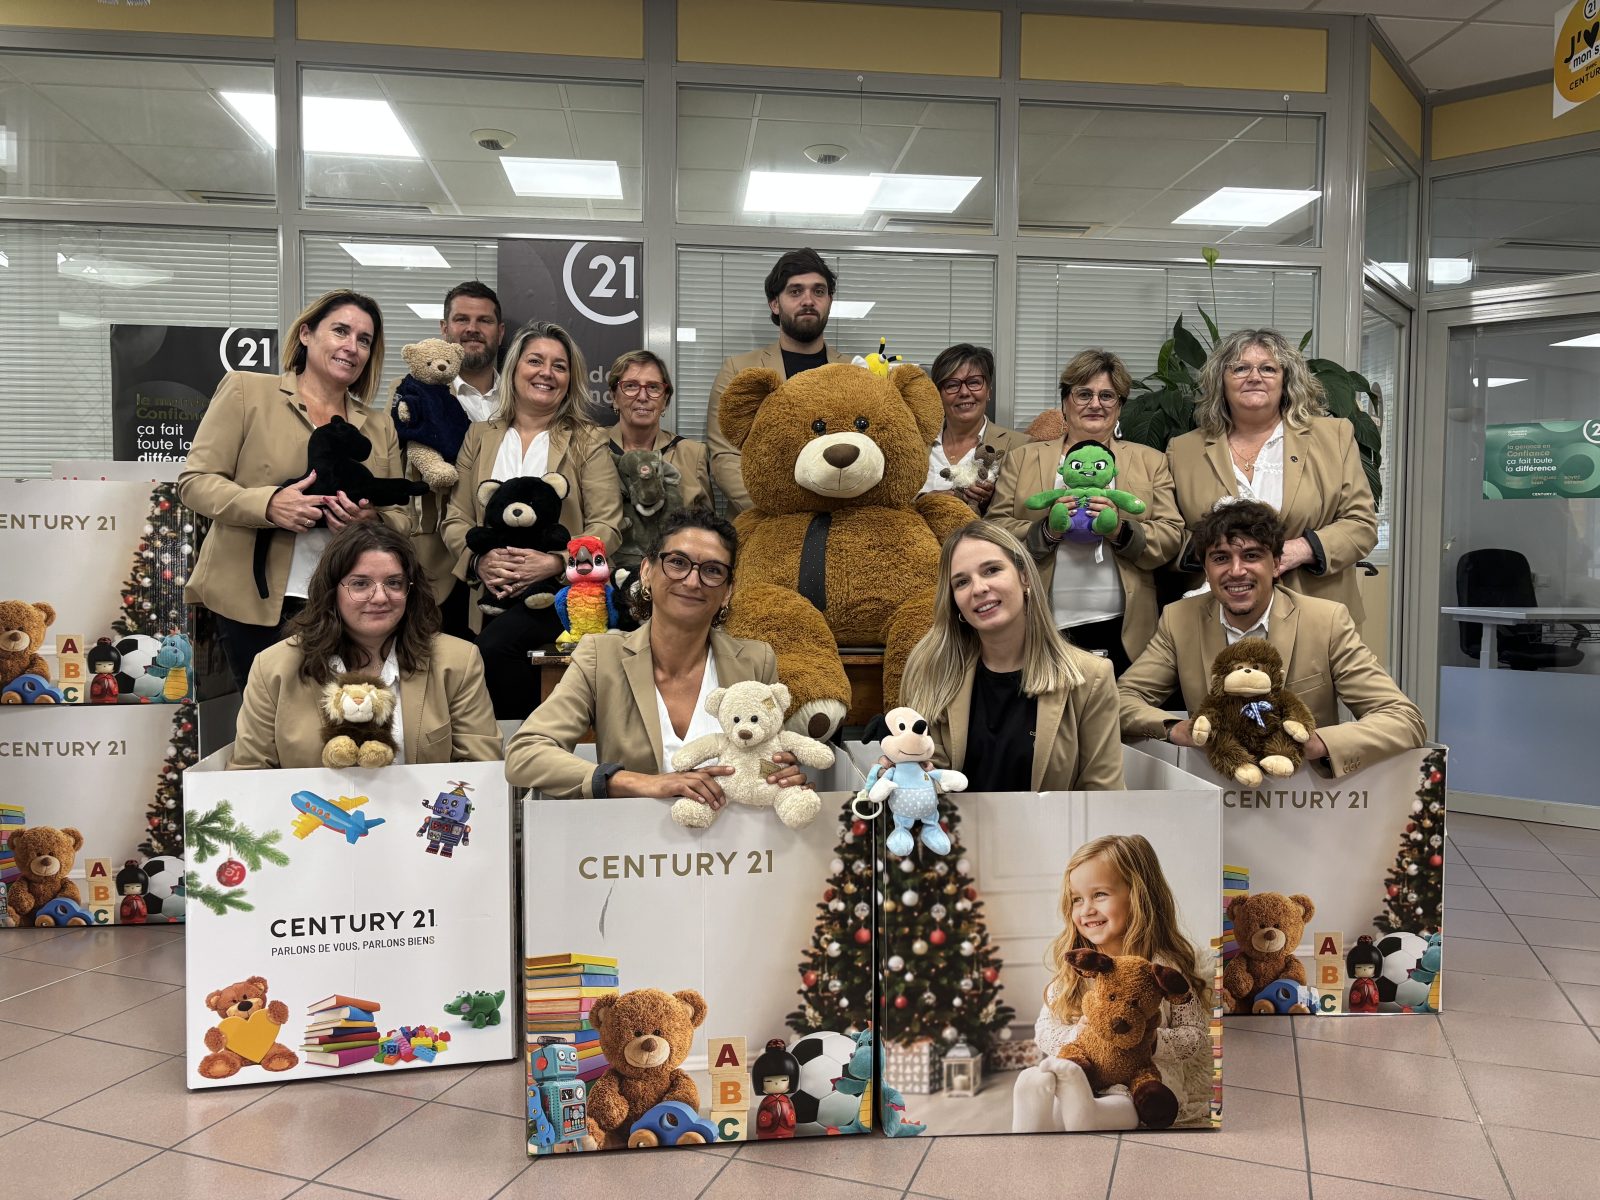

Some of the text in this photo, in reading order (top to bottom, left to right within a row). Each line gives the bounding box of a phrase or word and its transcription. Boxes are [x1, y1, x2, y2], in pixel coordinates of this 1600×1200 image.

[1573, 50, 1592, 68] mon
[137, 423, 183, 438] ça fait
[137, 438, 173, 450] toute
[97, 515, 116, 531] 21
[61, 639, 78, 654] A
[64, 663, 80, 679] B
[64, 687, 79, 702] C
[0, 740, 127, 757] CENTURY 21
[1223, 790, 1369, 809] CENTURY 21
[90, 862, 107, 878] A
[578, 849, 774, 880] CENTURY 21
[94, 886, 110, 901] B
[94, 909, 109, 924] C
[270, 908, 438, 938] CENTURY 21
[271, 935, 435, 957] PARLONS DE VOUS, PARLONS BIENS
[1319, 937, 1338, 955] A
[1321, 965, 1339, 984] B
[1319, 994, 1337, 1013] C
[715, 1043, 740, 1067] A
[719, 1080, 742, 1105] B
[717, 1117, 741, 1141] C
